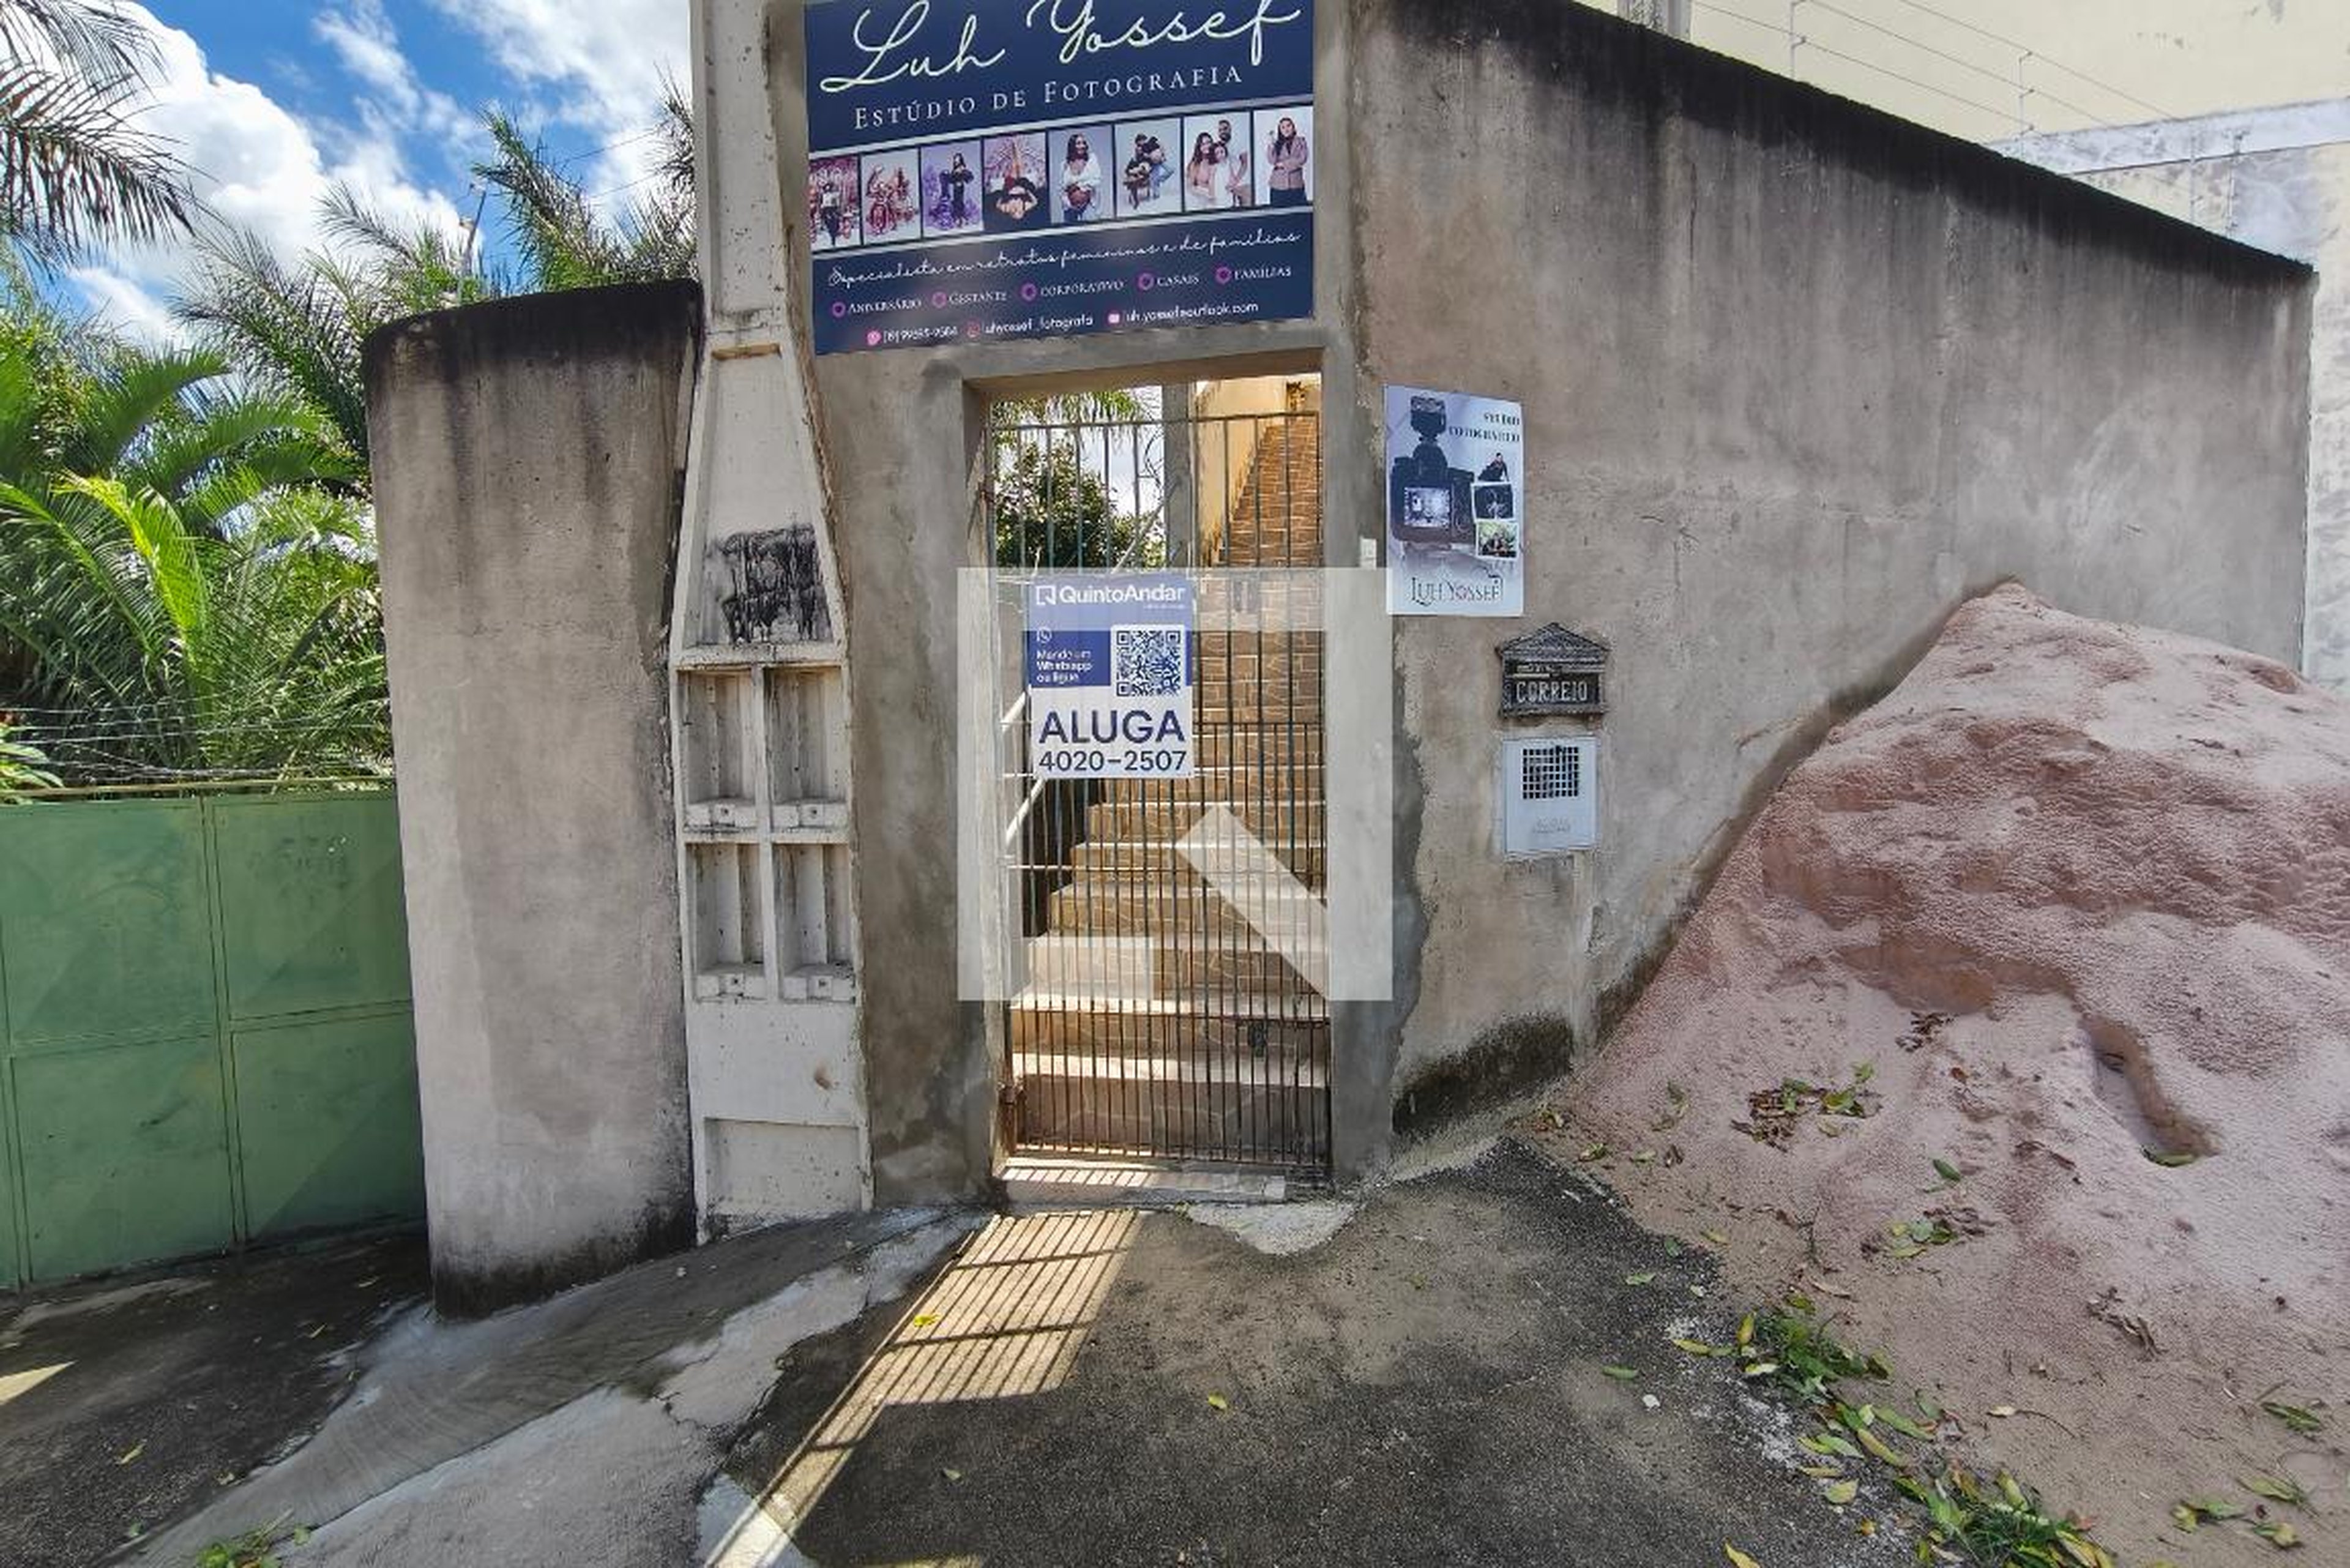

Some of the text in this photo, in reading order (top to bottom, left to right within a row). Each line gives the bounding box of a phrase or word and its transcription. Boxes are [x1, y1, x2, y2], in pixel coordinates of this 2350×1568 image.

[820, 0, 1005, 92] Luh
[992, 90, 1026, 110] DE
[1044, 65, 1242, 103] FOTOGRAFIA
[1059, 583, 1186, 604] QuintoAndar
[1516, 681, 1587, 703] CORREIO
[1039, 709, 1186, 744] ALUGA
[1039, 750, 1187, 771] 4020-2507
